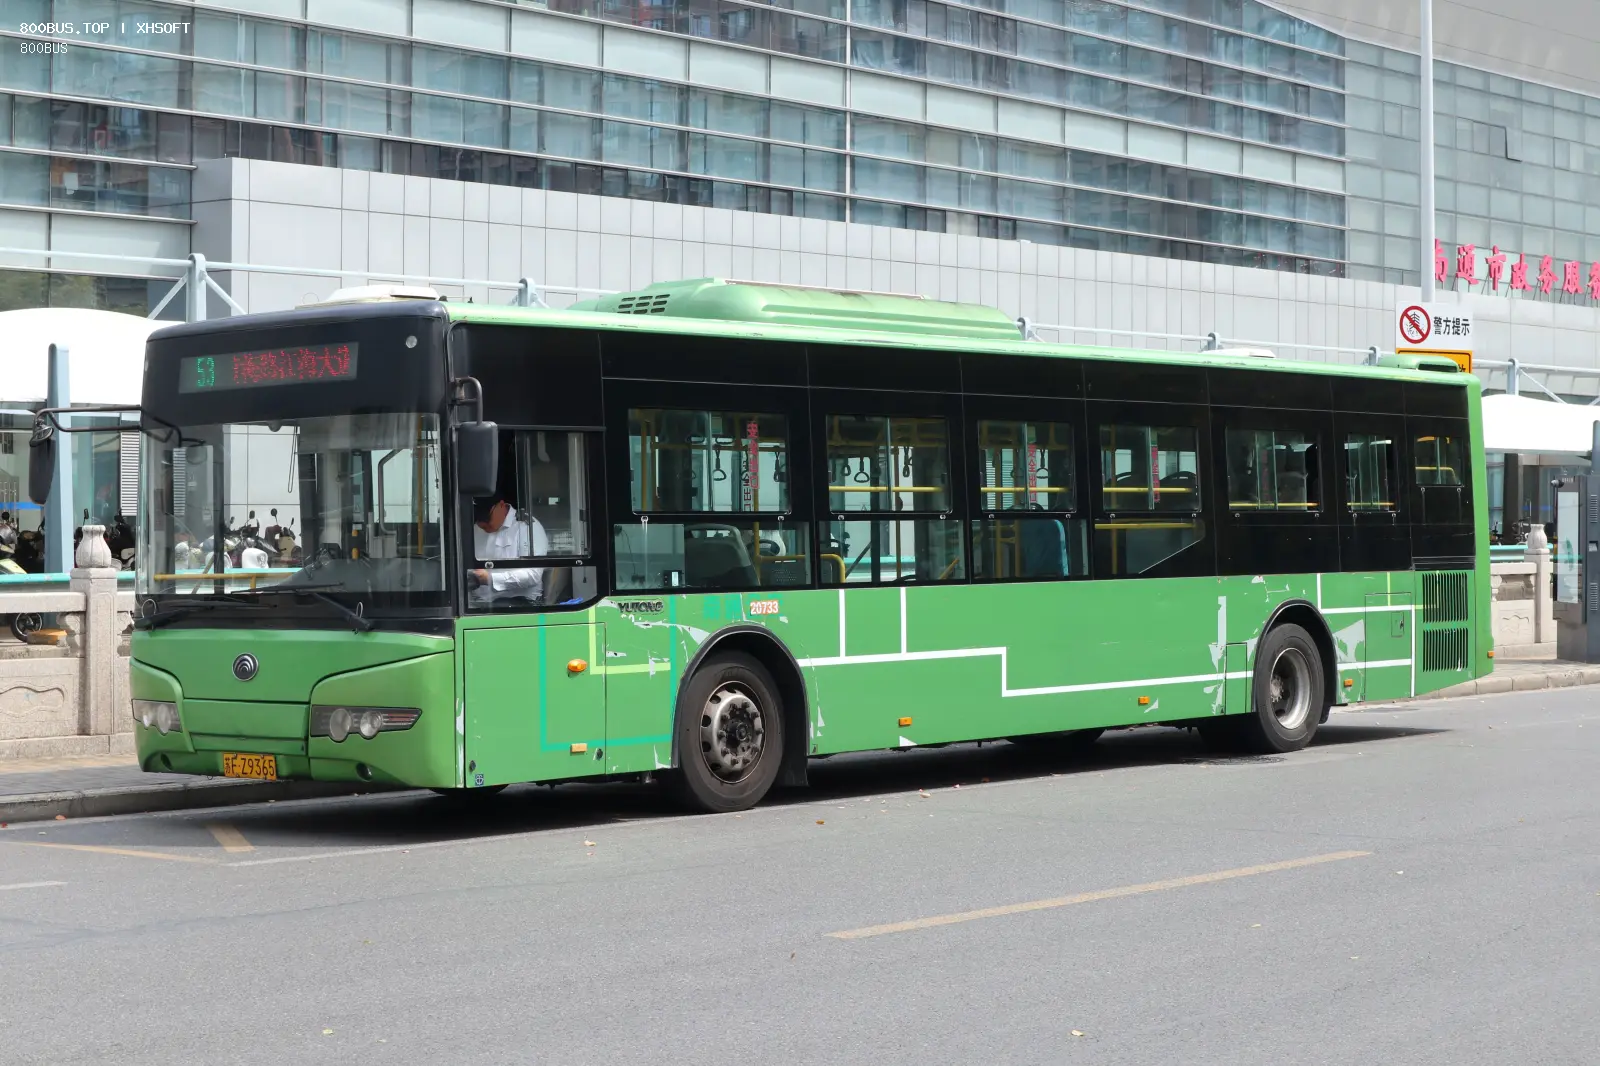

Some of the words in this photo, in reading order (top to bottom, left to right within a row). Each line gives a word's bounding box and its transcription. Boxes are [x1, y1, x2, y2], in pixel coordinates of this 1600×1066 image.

[1433, 316, 1470, 336] 警方提示
[197, 357, 215, 387] 53
[618, 600, 664, 614] YUTONG
[750, 601, 779, 615] 20733
